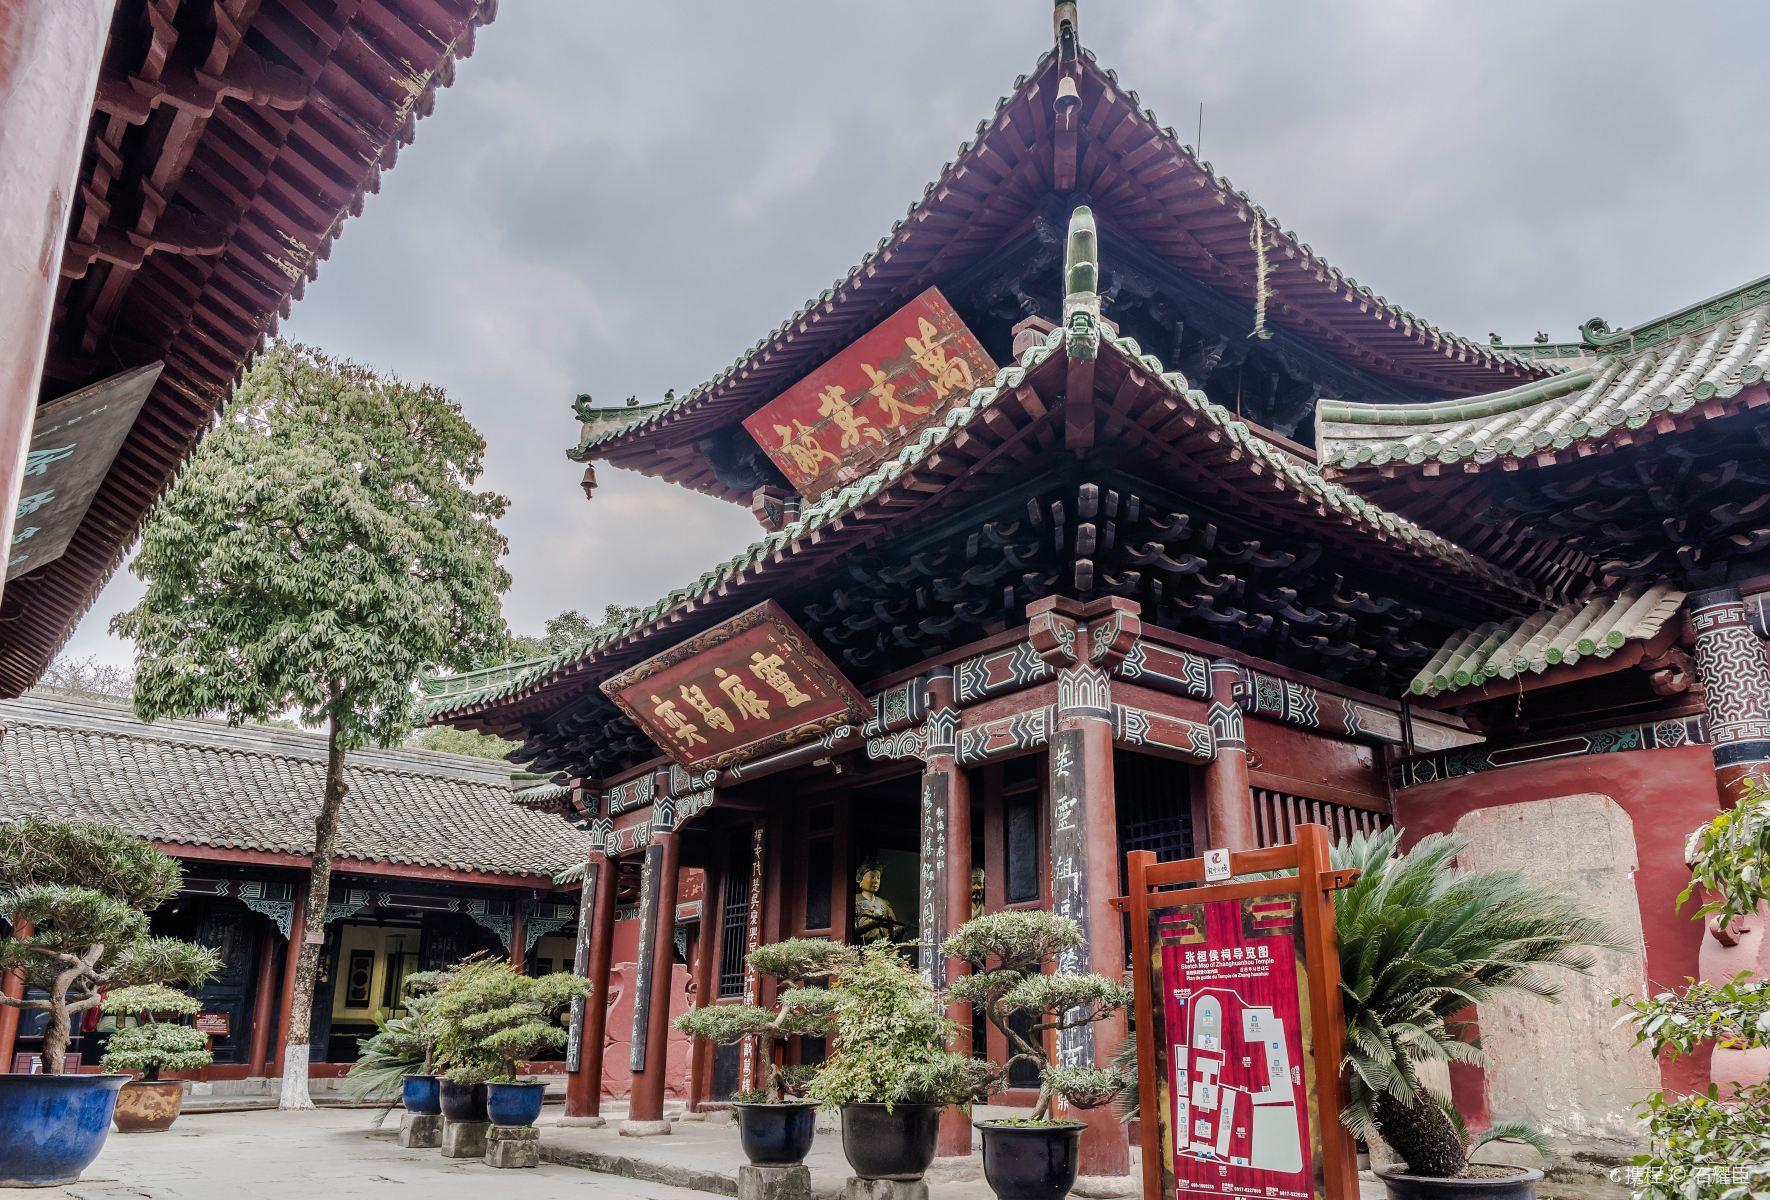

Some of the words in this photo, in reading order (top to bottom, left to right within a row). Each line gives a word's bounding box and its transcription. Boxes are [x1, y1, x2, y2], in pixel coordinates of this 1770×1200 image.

[1185, 945, 1269, 964] 张桓侯祠导览图
[1198, 962, 1209, 970] Map
[1255, 957, 1274, 966] Temple
